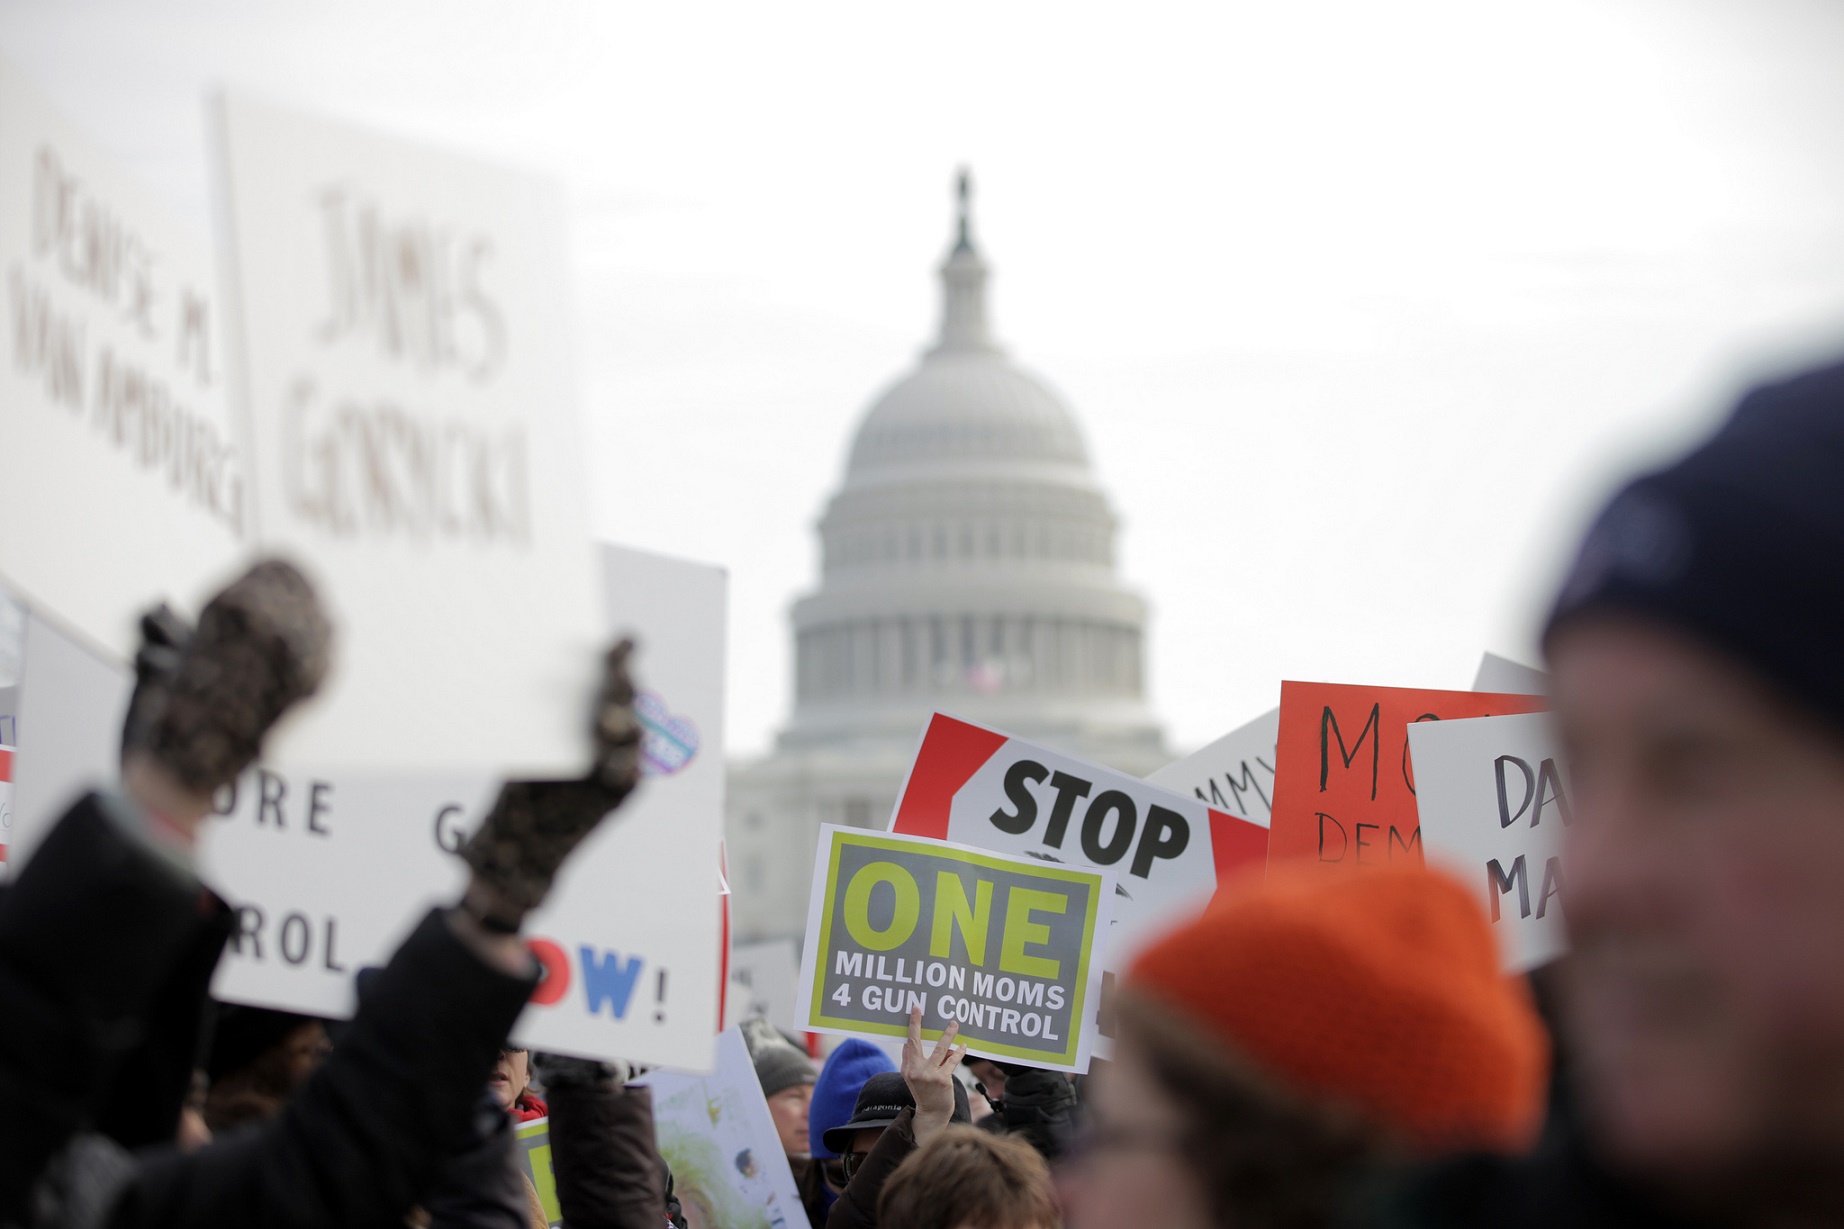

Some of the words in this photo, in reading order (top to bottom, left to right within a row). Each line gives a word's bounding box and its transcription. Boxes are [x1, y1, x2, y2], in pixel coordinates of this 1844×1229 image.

[311, 178, 511, 387] JAMES
[989, 759, 1190, 880] STOP
[843, 861, 1068, 980] ONE
[831, 982, 852, 1007] 4
[861, 985, 928, 1017] GUN
[936, 994, 1059, 1041] CONTROL
[834, 950, 966, 992] MILLION
[972, 970, 1066, 1011] MOMS
